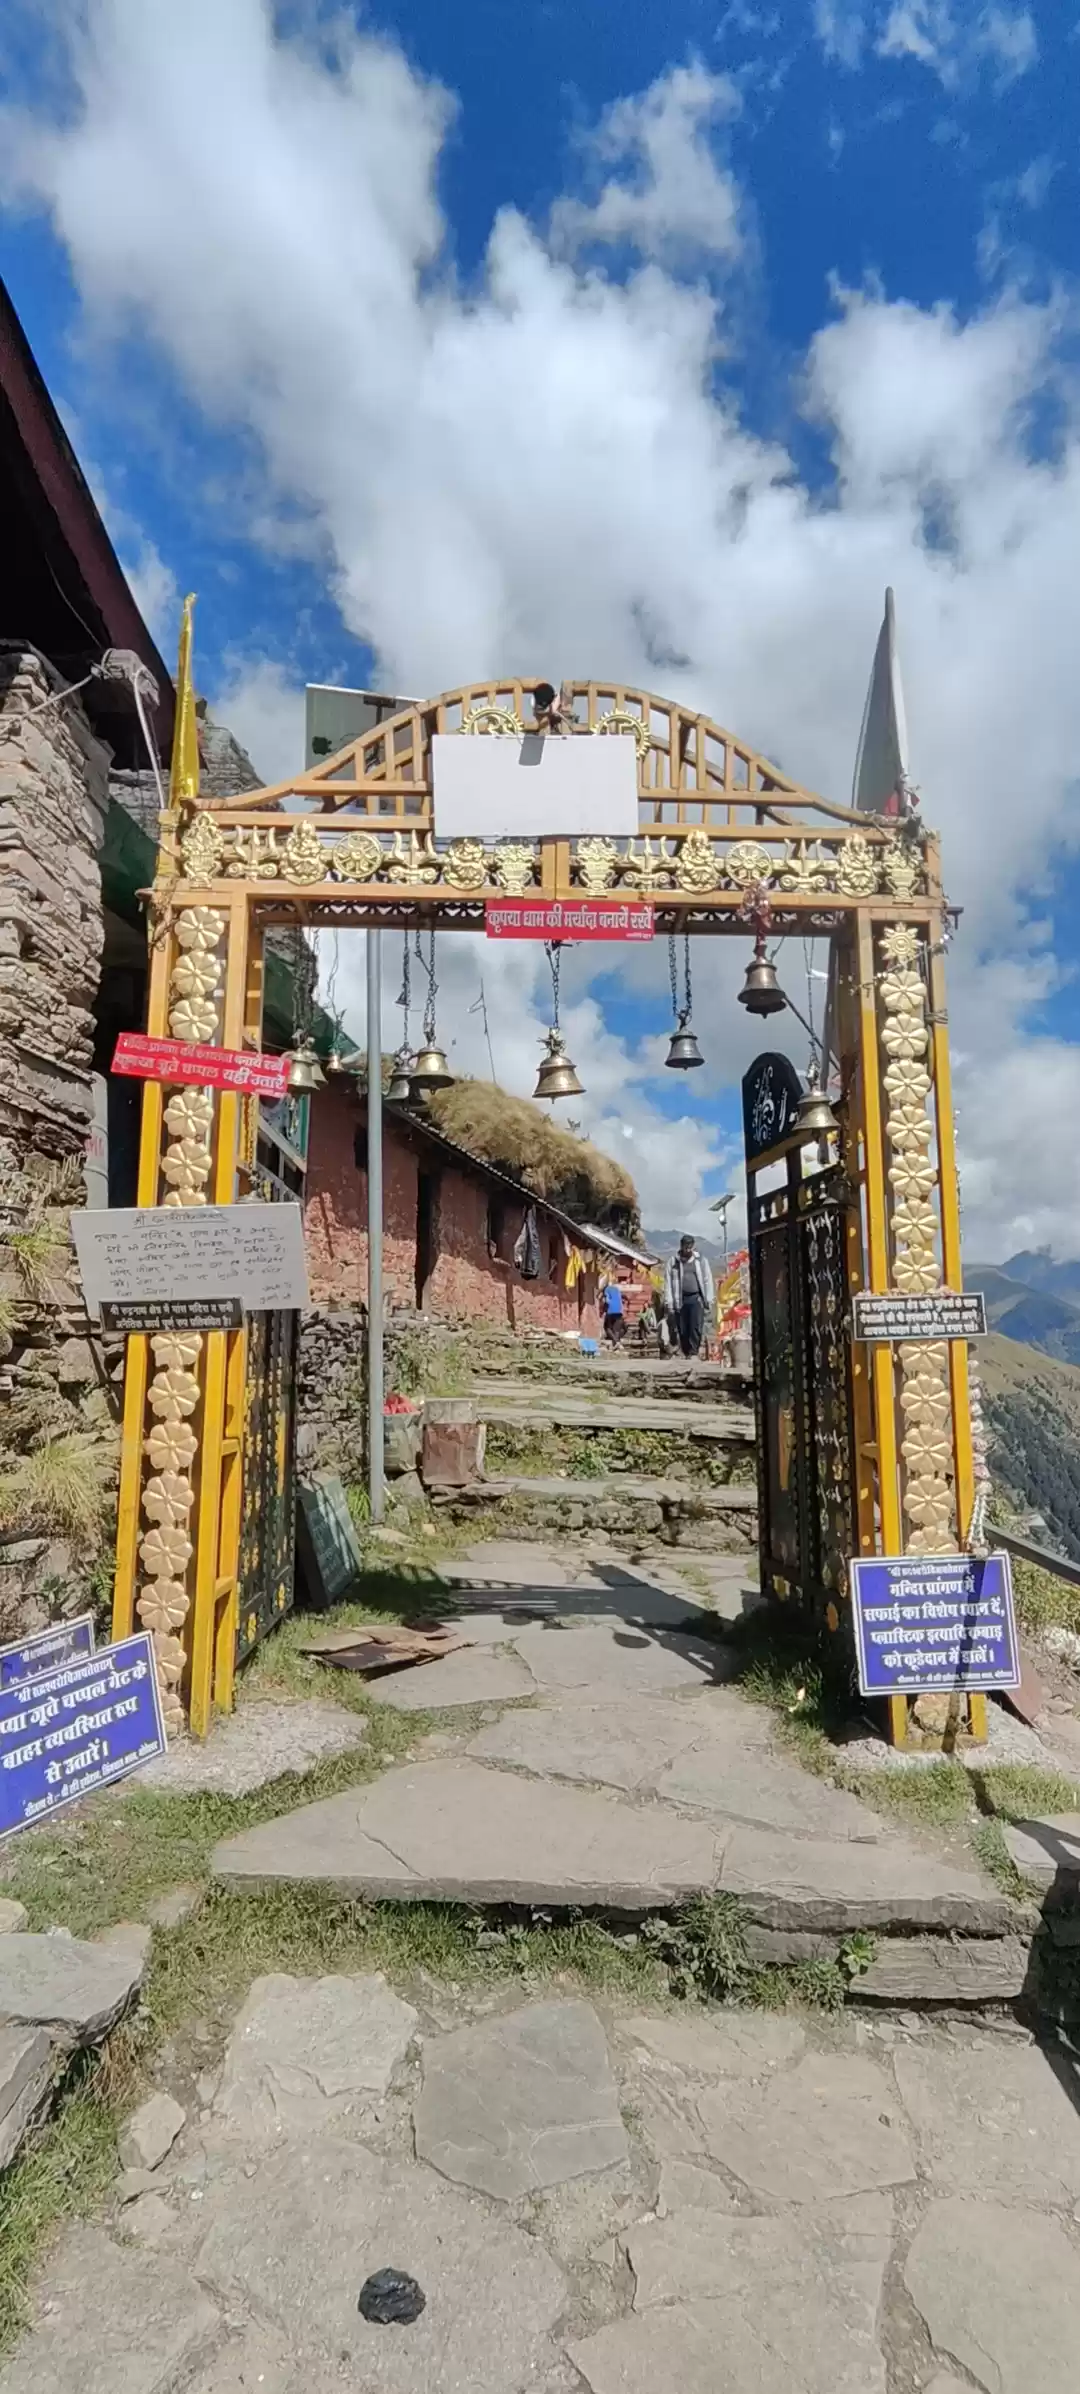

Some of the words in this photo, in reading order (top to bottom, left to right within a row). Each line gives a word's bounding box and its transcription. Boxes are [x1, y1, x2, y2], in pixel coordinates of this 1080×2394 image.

[488, 909, 520, 933] कृपया
[523, 910, 545, 927] धाम
[546, 903, 562, 928] की
[564, 905, 597, 930] मर्यादा
[110, 1303, 119, 1316] श्री
[889, 1579, 924, 1597] मन्दिर
[926, 1576, 963, 1595] प्रांगण
[964, 1575, 975, 1593] में
[864, 1601, 901, 1623] सफाई
[902, 1605, 920, 1620] का
[922, 1601, 958, 1619] विशेष
[871, 1627, 925, 1645] प्लास्टिक
[926, 1623, 967, 1645] इत्यादि
[882, 1650, 904, 1668] को
[947, 1645, 960, 1664] में
[29, 1696, 59, 1727] जूते
[61, 1679, 107, 1709] चप्पल
[108, 1671, 132, 1690] गेट
[133, 1660, 148, 1681] के
[1, 1737, 44, 1771] बाहर
[44, 1713, 113, 1749] व्यवस्थित
[44, 1760, 64, 1785] से
